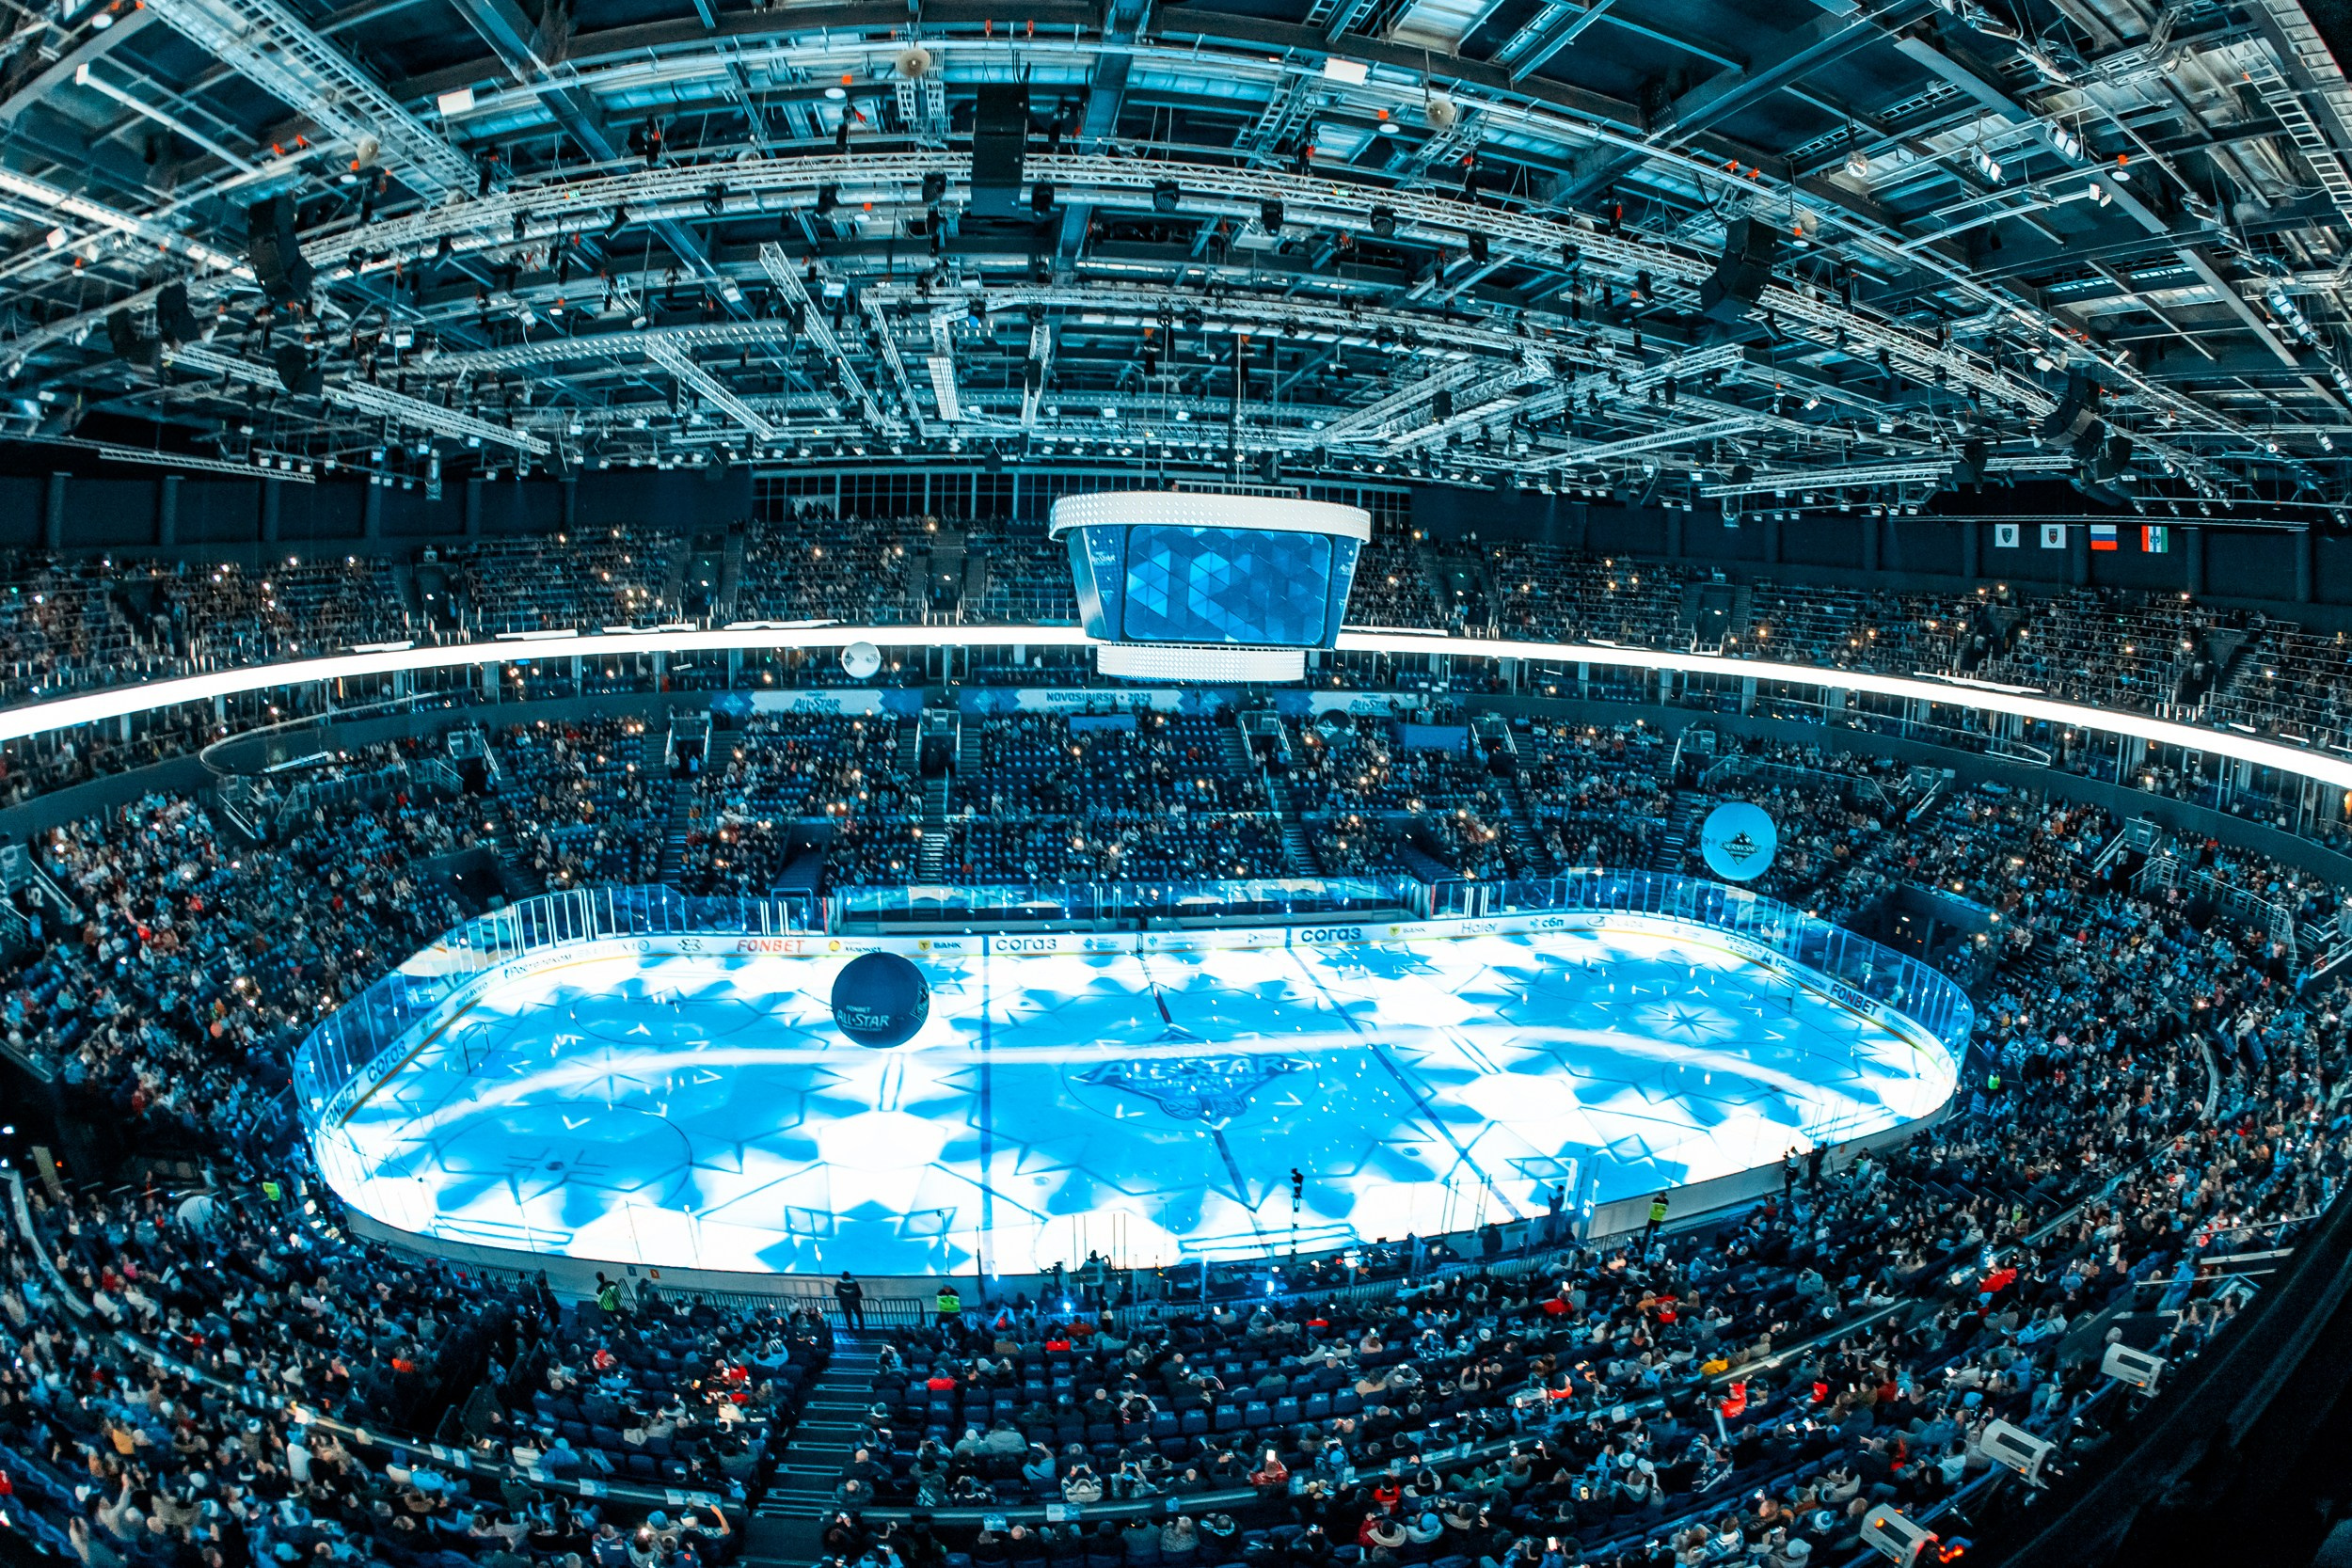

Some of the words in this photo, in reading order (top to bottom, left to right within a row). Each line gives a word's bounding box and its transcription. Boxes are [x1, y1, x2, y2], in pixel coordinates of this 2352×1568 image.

[1046, 691, 1117, 703] NOVOSIBIRSK
[1127, 692, 1152, 703] 2025
[1301, 927, 1362, 942] согаз
[1461, 922, 1498, 934] Haier
[737, 940, 805, 953] FONBET
[995, 938, 1057, 951] согаз
[1829, 983, 1881, 1017] FONBET
[326, 1078, 358, 1127] FONBET
